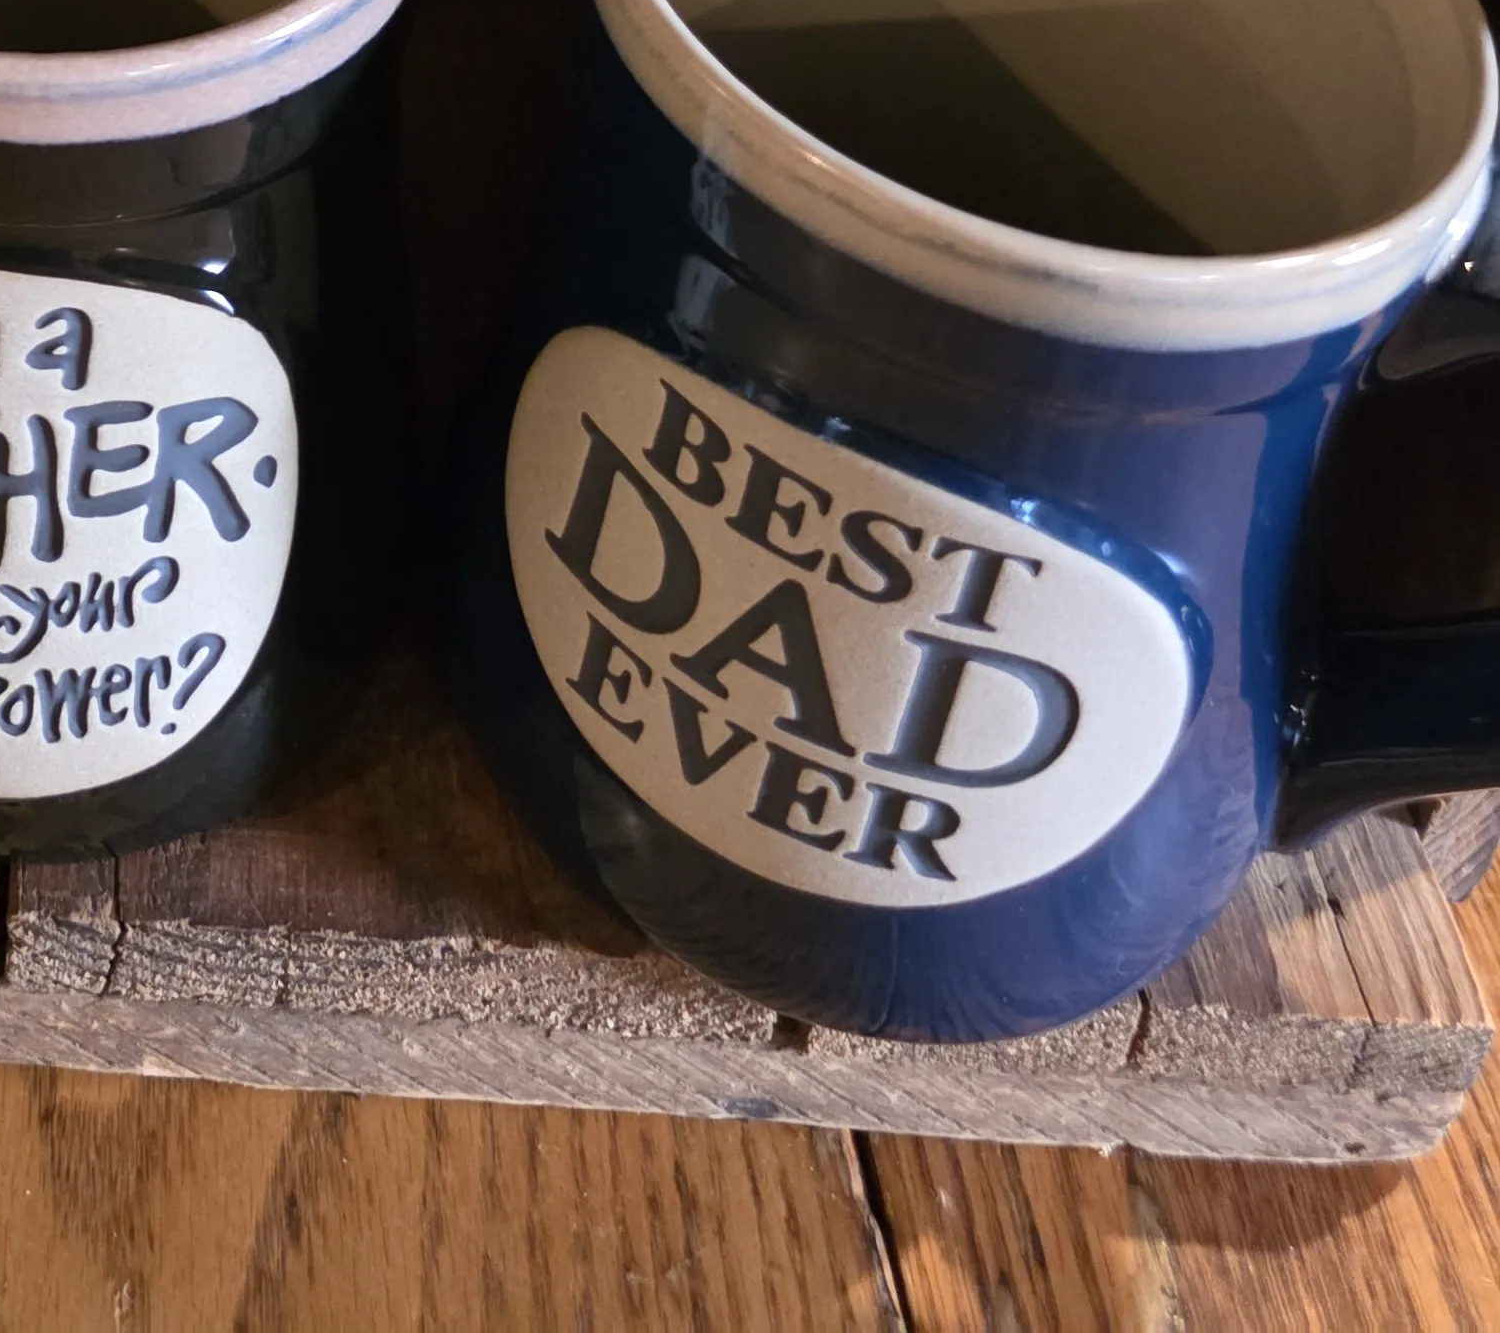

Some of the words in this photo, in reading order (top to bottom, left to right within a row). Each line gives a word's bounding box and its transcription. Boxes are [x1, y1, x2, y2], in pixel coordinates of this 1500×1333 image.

[25, 307, 93, 391] a
[544, 411, 1081, 789] DAD
[641, 378, 1042, 632] BEST
[566, 611, 961, 882] EVER
